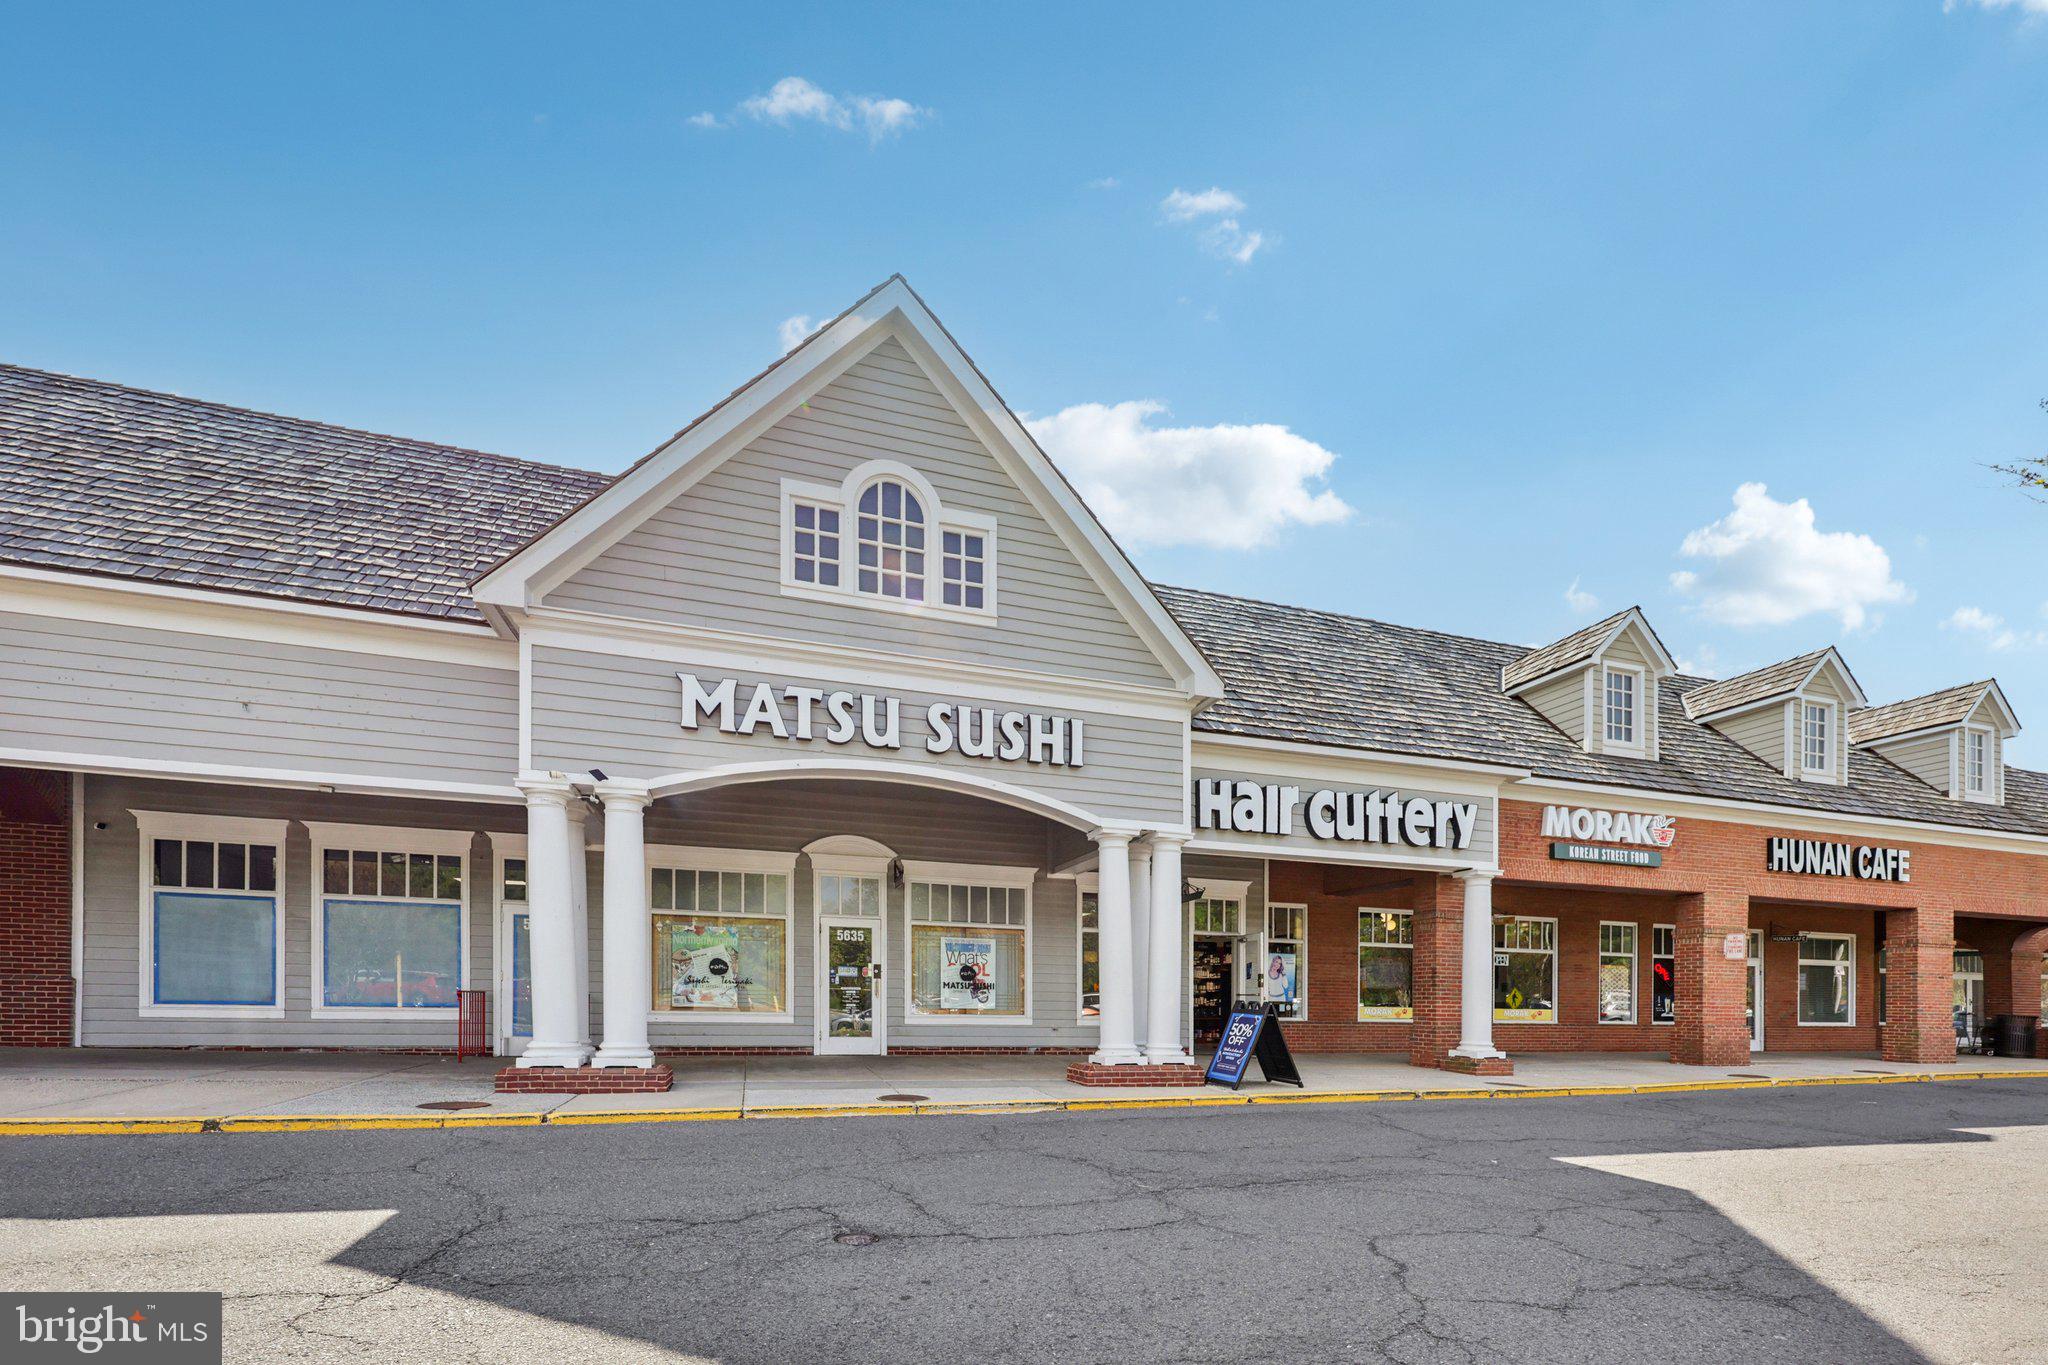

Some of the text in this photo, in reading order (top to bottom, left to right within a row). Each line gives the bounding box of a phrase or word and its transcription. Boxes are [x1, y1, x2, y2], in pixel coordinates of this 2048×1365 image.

[675, 672, 1085, 767] MATSU SUSHI
[1195, 778, 1479, 850] Hair cuttery
[1541, 805, 1655, 845] MORAK
[1569, 845, 1650, 864] KOREAN STREET FOOD
[1767, 837, 1911, 882] HUNAN CAFE
[836, 930, 865, 941] 5635
[721, 975, 753, 988] Teriyaki
[943, 981, 970, 990] MATSU
[1229, 1022, 1254, 1038] 50%
[1228, 1035, 1247, 1046] OFF
